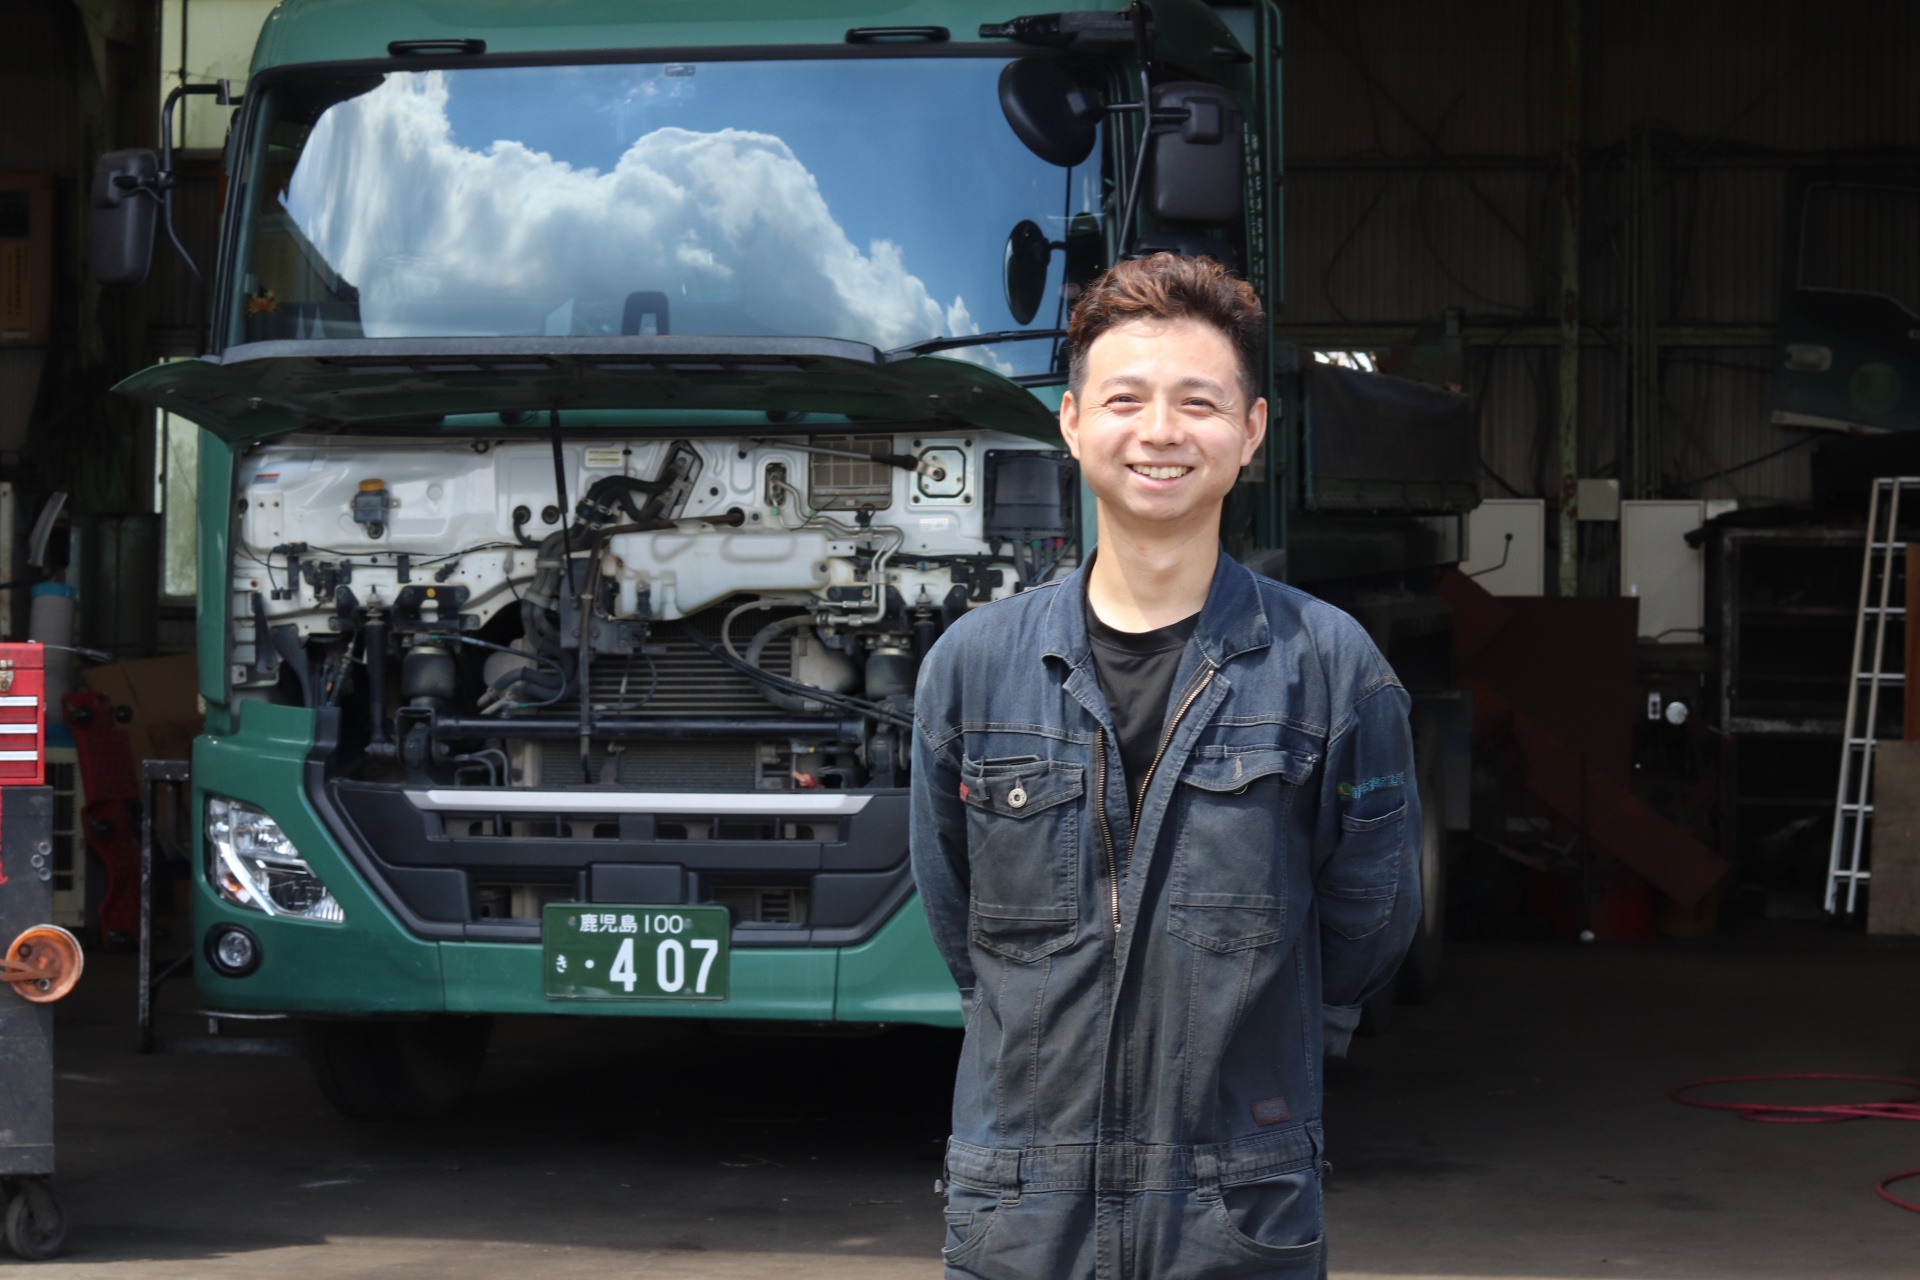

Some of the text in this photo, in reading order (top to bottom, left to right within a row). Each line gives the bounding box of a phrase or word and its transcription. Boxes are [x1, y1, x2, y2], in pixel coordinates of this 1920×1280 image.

[579, 913, 684, 934] 鹿児島 100
